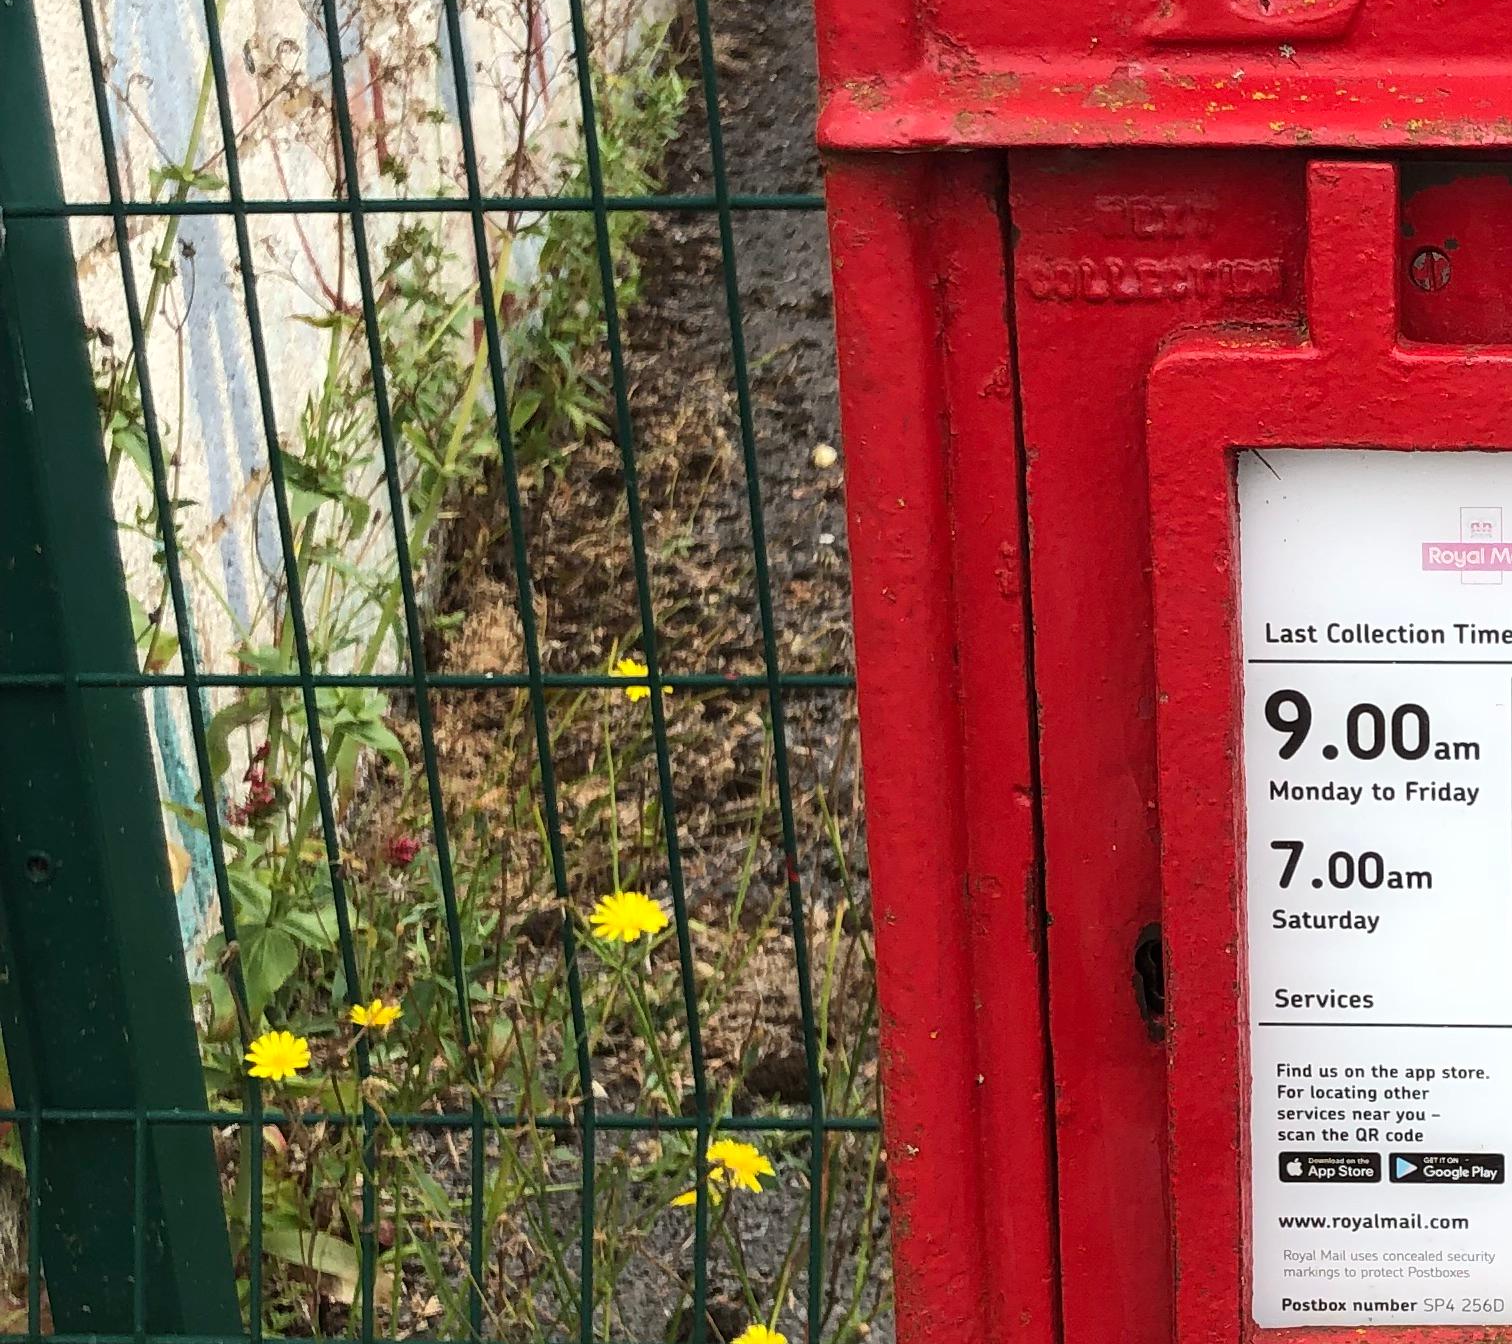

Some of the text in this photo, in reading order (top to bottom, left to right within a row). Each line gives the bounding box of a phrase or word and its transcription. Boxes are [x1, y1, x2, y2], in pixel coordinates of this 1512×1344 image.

[1428, 546, 1485, 568] Royal
[1265, 622, 1318, 644] Last
[1326, 622, 1445, 645] Collection
[1264, 688, 1480, 761] 9.00am
[1269, 780, 1480, 807] Monday to Friday
[1270, 840, 1433, 890] 7.00am
[1272, 908, 1380, 934] Saturday
[1274, 988, 1374, 1009] Services
[1276, 1063, 1490, 1082] Find us on the app store.
[1277, 1084, 1430, 1103] For locating other
[1277, 1106, 1346, 1121] services
[1351, 1110, 1391, 1121] near
[1395, 1110, 1426, 1124] you
[1277, 1127, 1424, 1143] scan the QR code
[1308, 1164, 1374, 1179] App Store
[1423, 1165, 1498, 1181] Google Play
[1278, 1213, 1469, 1233] www.royalmail.com
[1283, 1249, 1496, 1265] Royal Mail uses concealed security
[1283, 1266, 1471, 1281] markings to protect Postboxes
[1281, 1297, 1418, 1312] Postbox number
[1423, 1297, 1505, 1313] SP4 256D
